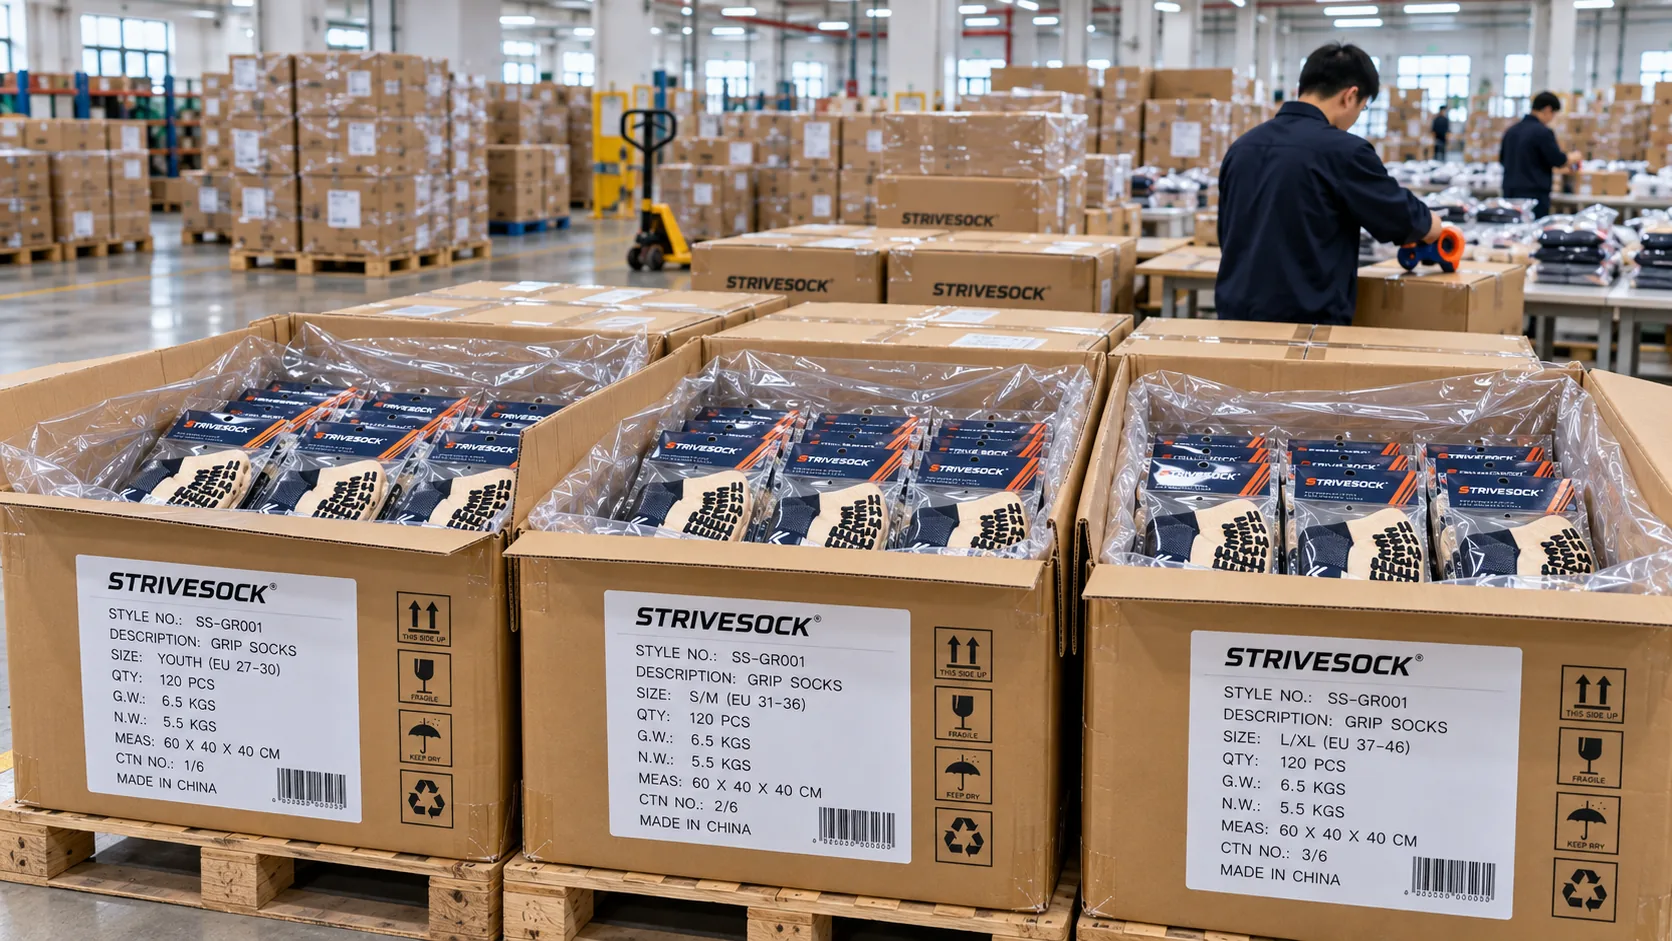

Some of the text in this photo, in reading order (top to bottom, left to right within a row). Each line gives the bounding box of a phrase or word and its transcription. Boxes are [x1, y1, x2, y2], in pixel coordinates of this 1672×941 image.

[183, 419, 252, 434] STRIVESOCK
[314, 431, 383, 445] STRIVESOCK
[665, 441, 738, 455] STRIVESOCK
[797, 454, 871, 467] STRIVESOCK
[929, 463, 1005, 476] STRIVESOCK
[1305, 477, 1385, 490] STRIVESOCK
[1458, 485, 1540, 497] STRIVESOCK
[109, 608, 262, 633] STYLE NO.: SS-GR001
[110, 628, 297, 657] DESCRIPTION: GRIP SOCKS
[111, 648, 280, 677] SIZE: YOUTH (EU 27-30)
[636, 644, 804, 667] STYLE NO.: SS-GR001
[112, 669, 215, 690] QTY: 120 PCS
[636, 666, 842, 692] DESCRIPTION: GRIP SOCKS
[113, 690, 216, 711] G.W.: 6.5 KGS
[637, 686, 806, 712] SIZE: S/M (EU 31-36)
[1224, 686, 1407, 709] STYLE NO.: SS-GR001
[114, 711, 217, 732] N.W.: 5.5 KGS
[637, 708, 750, 728] QTY: 120 PCS
[1224, 708, 1448, 734] DESCRIPTION: GRIP SOCKS
[1606, 712, 1618, 720] UP
[115, 732, 280, 760] MEAS: 60 X 40 X 40 CM
[637, 729, 751, 750] G.W.: 6.5 KGS
[1223, 730, 1410, 755] SIZE: L/XL (EU 37-46)
[116, 752, 204, 772] CTN NO.: 1/6
[638, 751, 751, 771] N.W.: 5.5 KGS
[1223, 752, 1346, 772] QTY: 120 PCS
[117, 773, 217, 794] MADE IN CHINA
[639, 772, 822, 799] MEAS: 60 X 40 X 40 CM
[1222, 774, 1346, 795] G.W.: 6.5 KGS
[639, 793, 738, 813] CTN NO.: 2/6
[1222, 797, 1345, 818] N.W.: 5.5 KGS
[640, 814, 751, 835] MADE IN CHINA
[1222, 819, 1417, 847] MEAS: 60 X 40 X 40 CM
[1221, 841, 1327, 862] CTN NO.: 3/6
[1221, 864, 1341, 886] MADE IN CHINA
